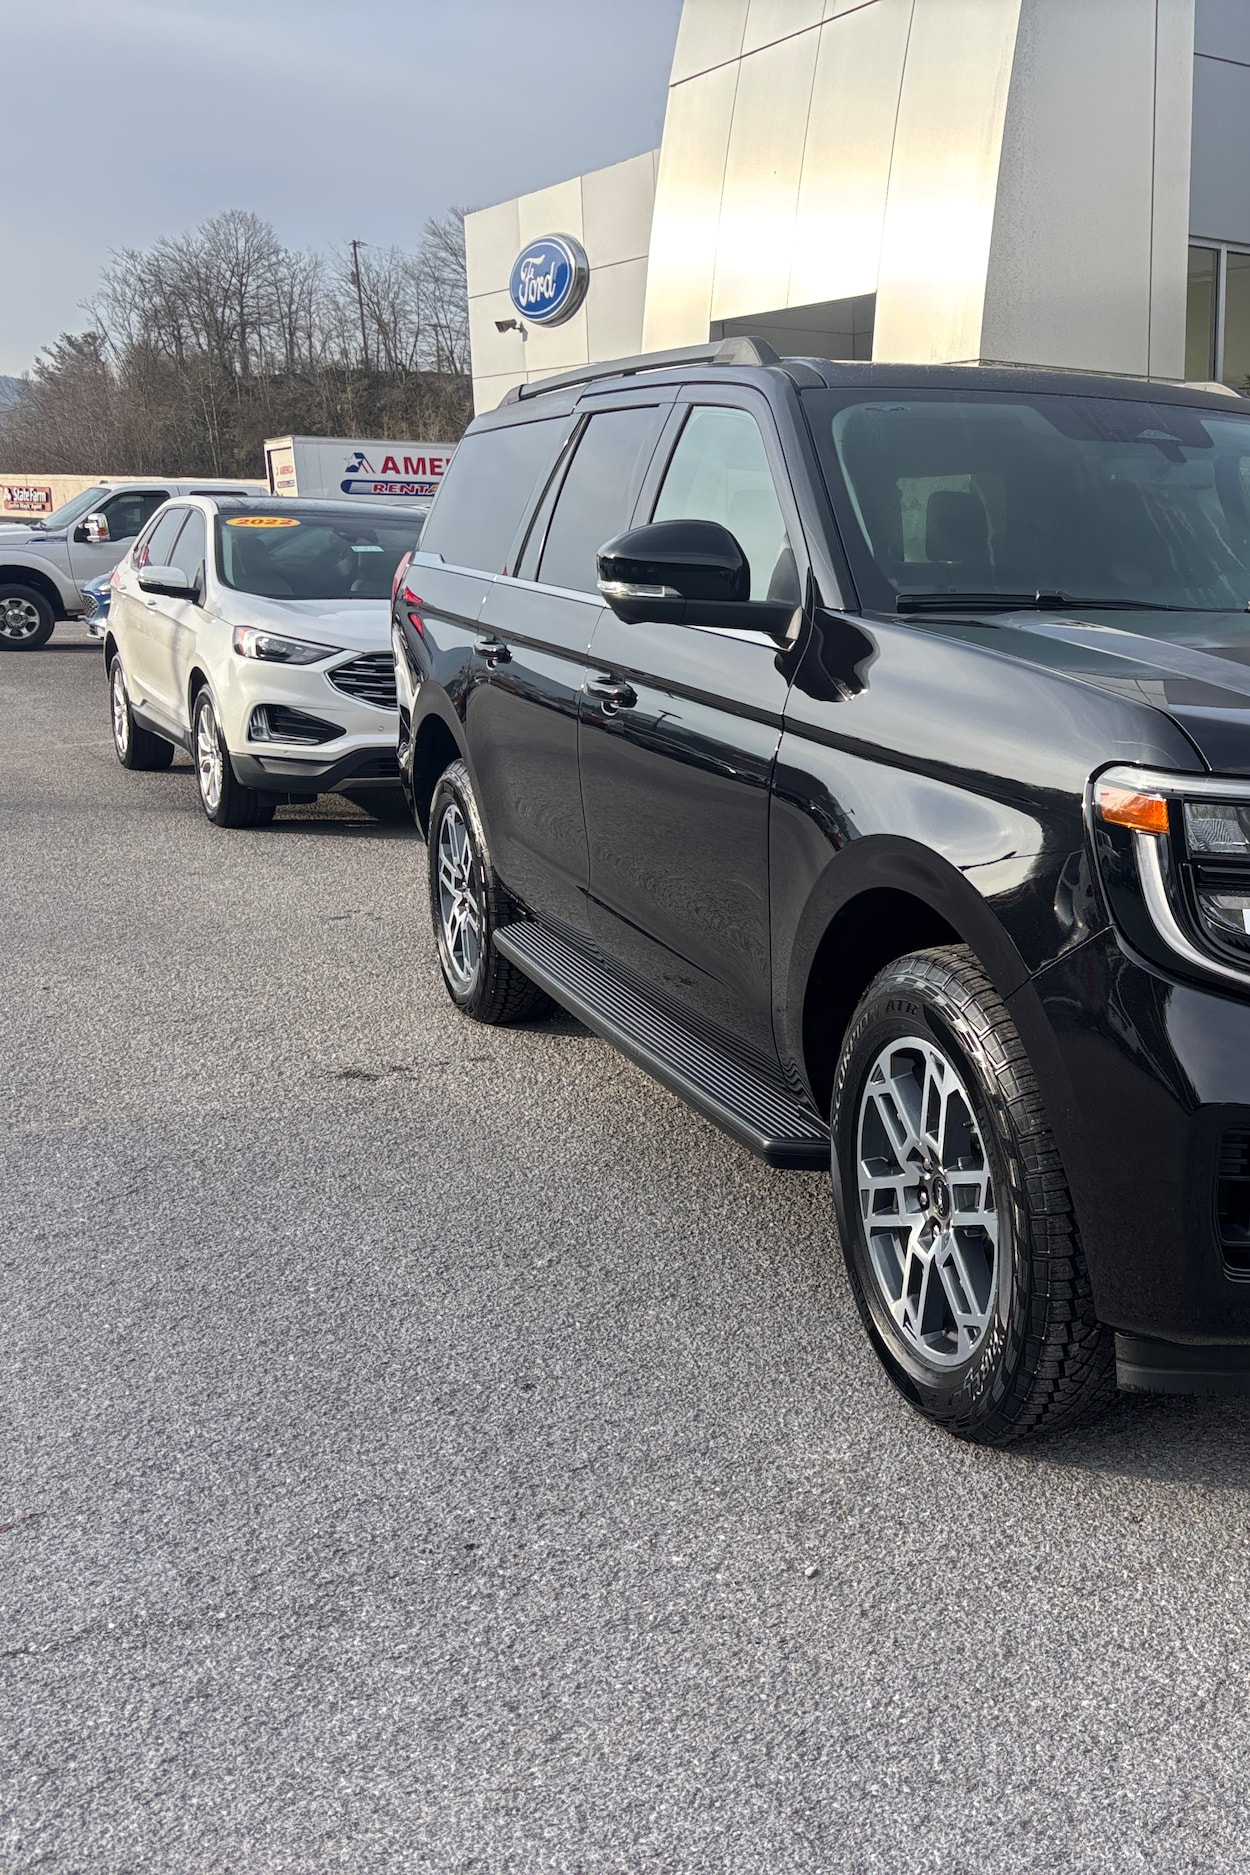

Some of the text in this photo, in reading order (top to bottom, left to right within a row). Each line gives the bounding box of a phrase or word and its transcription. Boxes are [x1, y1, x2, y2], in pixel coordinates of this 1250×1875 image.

[519, 254, 556, 307] Ford
[381, 456, 451, 476] AME
[885, 1000, 919, 1016] ATR
